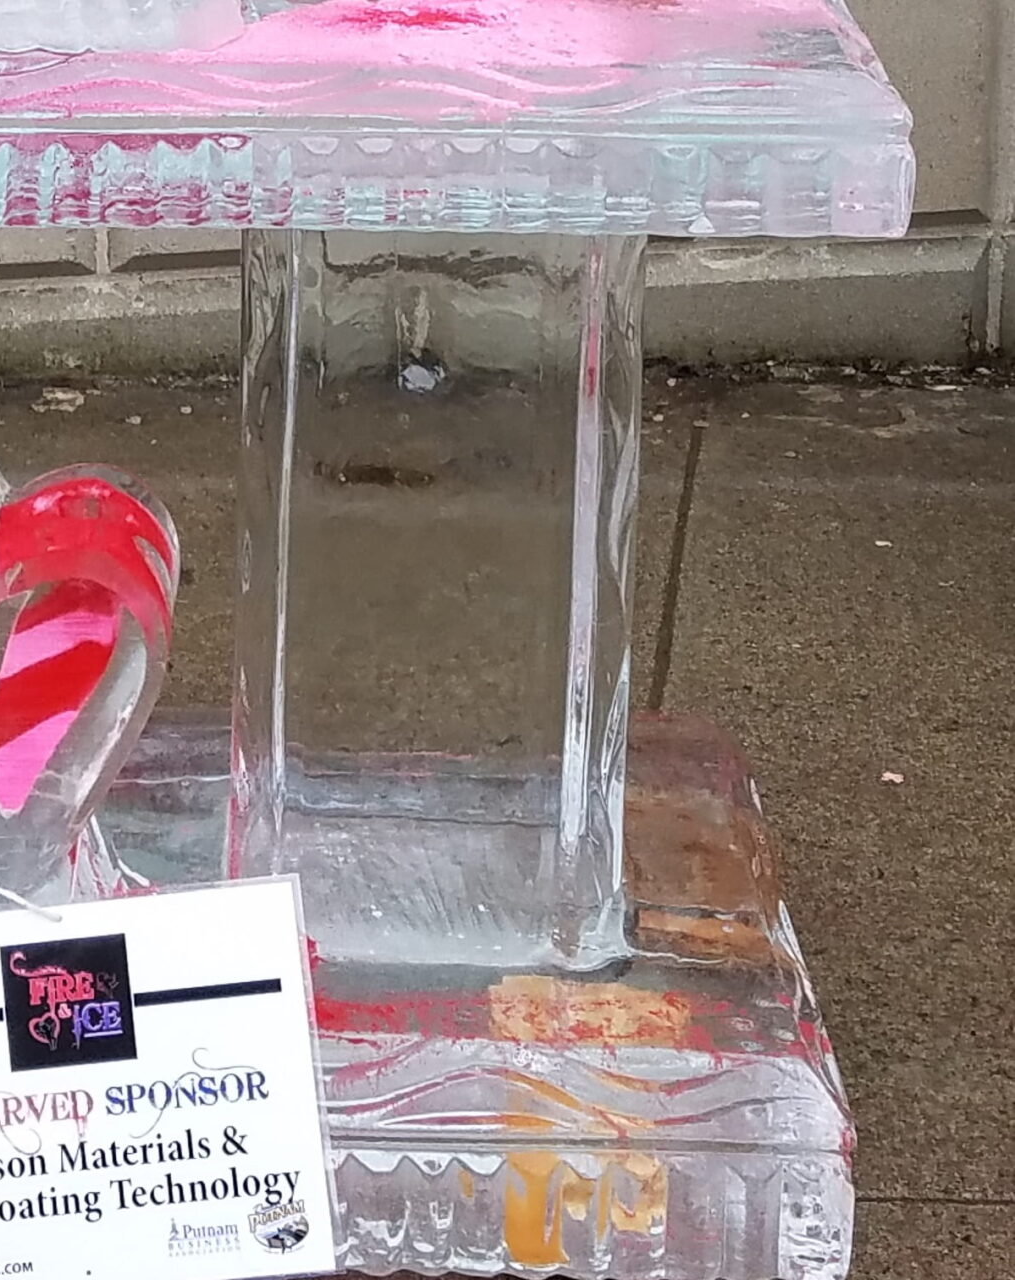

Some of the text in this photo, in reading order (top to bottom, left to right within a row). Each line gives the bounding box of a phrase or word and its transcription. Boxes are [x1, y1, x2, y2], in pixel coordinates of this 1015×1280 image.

[28, 970, 95, 1008] FIRE
[58, 1001, 123, 1035] & ICE
[104, 1070, 270, 1117] SPONSOR
[59, 1129, 211, 1173] Materials
[222, 1125, 248, 1156] &
[109, 1167, 301, 1211] Technology
[182, 1224, 238, 1239] Putnam
